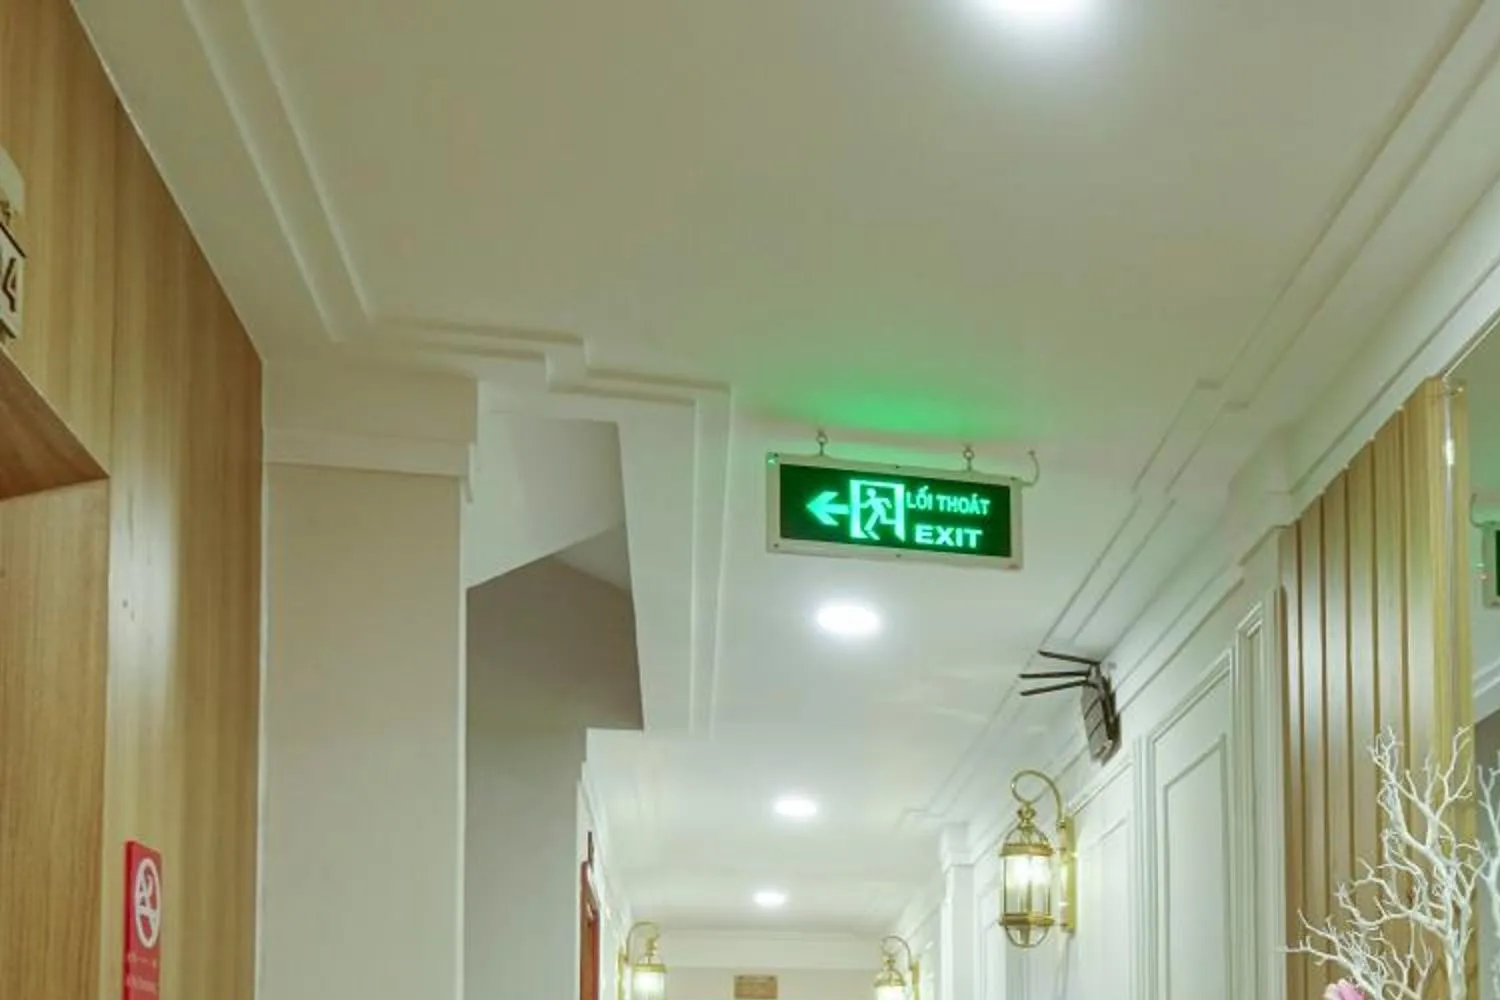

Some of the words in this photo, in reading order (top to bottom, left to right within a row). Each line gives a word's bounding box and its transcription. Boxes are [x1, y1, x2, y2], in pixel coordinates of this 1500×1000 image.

[0, 255, 17, 312] 4
[905, 485, 933, 511] LỐI
[936, 492, 991, 516] THOÁT
[915, 523, 984, 548] EXIT
